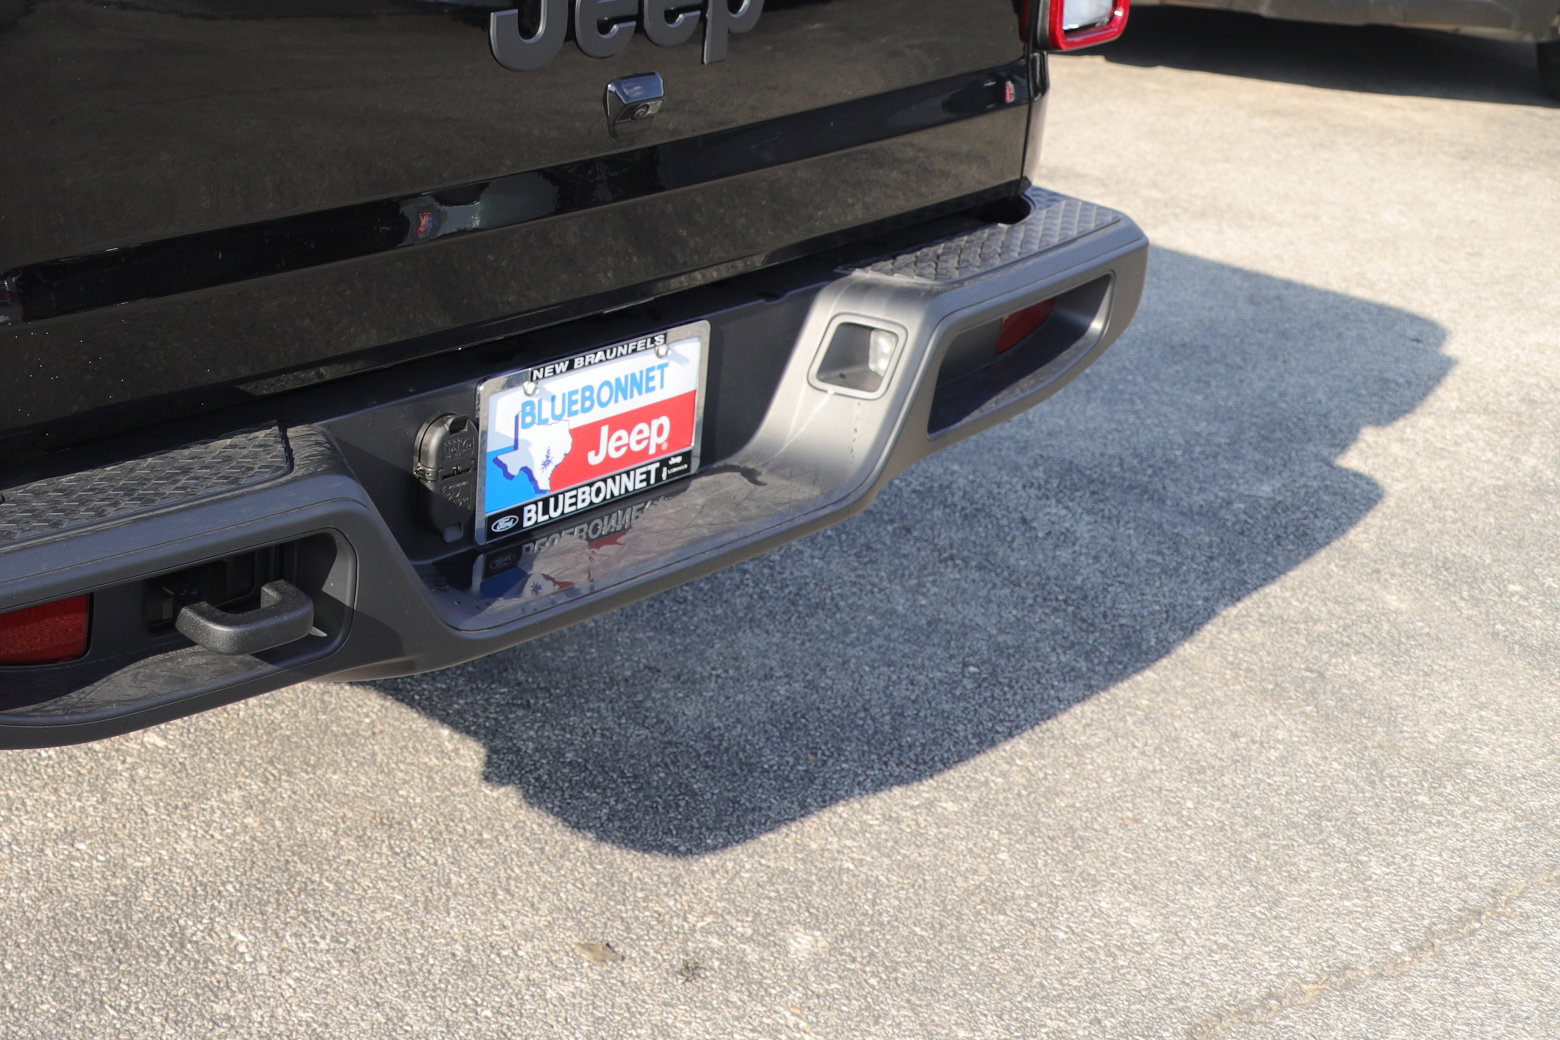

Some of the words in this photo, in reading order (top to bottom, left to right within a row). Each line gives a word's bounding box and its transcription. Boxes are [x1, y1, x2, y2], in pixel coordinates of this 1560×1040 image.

[532, 360, 569, 381] NEW
[573, 334, 666, 369] BRAUNFELS
[521, 362, 669, 430] BLUEBONNET
[587, 415, 670, 466] Jeep
[522, 463, 660, 528] BLUEBONNET
